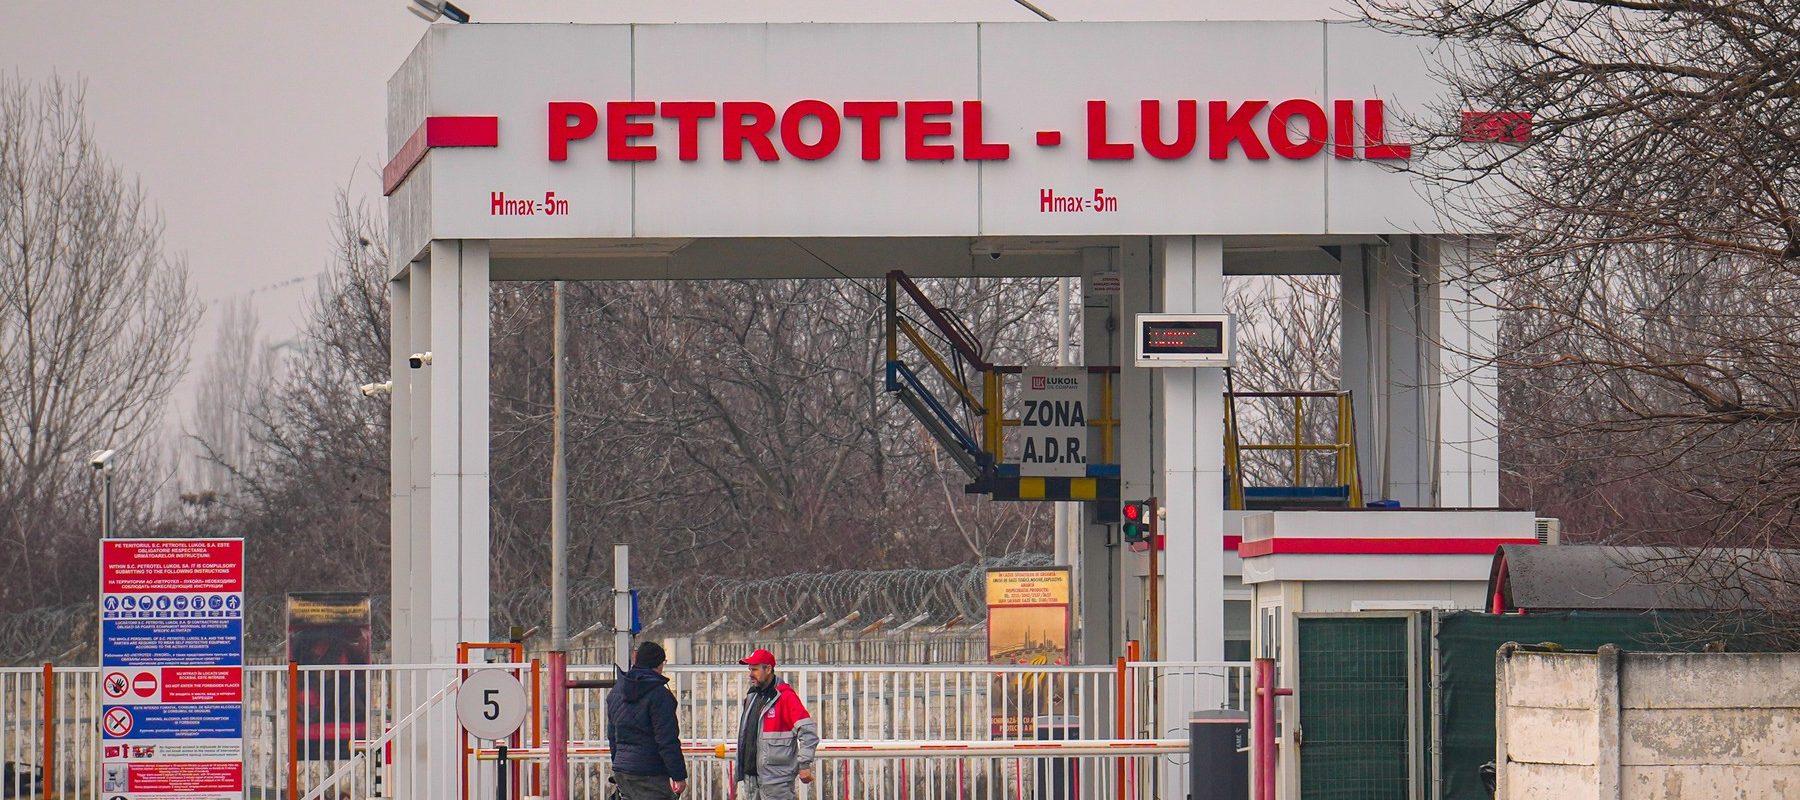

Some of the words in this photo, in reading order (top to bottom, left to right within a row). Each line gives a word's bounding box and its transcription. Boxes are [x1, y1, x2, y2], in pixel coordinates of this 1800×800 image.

[548, 99, 1011, 161] PETROTEL
[1036, 130, 1062, 146] -
[1088, 99, 1411, 160] LUKOIL
[1024, 400, 1085, 427] ZONA
[1022, 437, 1086, 463] A.D.R.
[484, 690, 499, 720] 5
